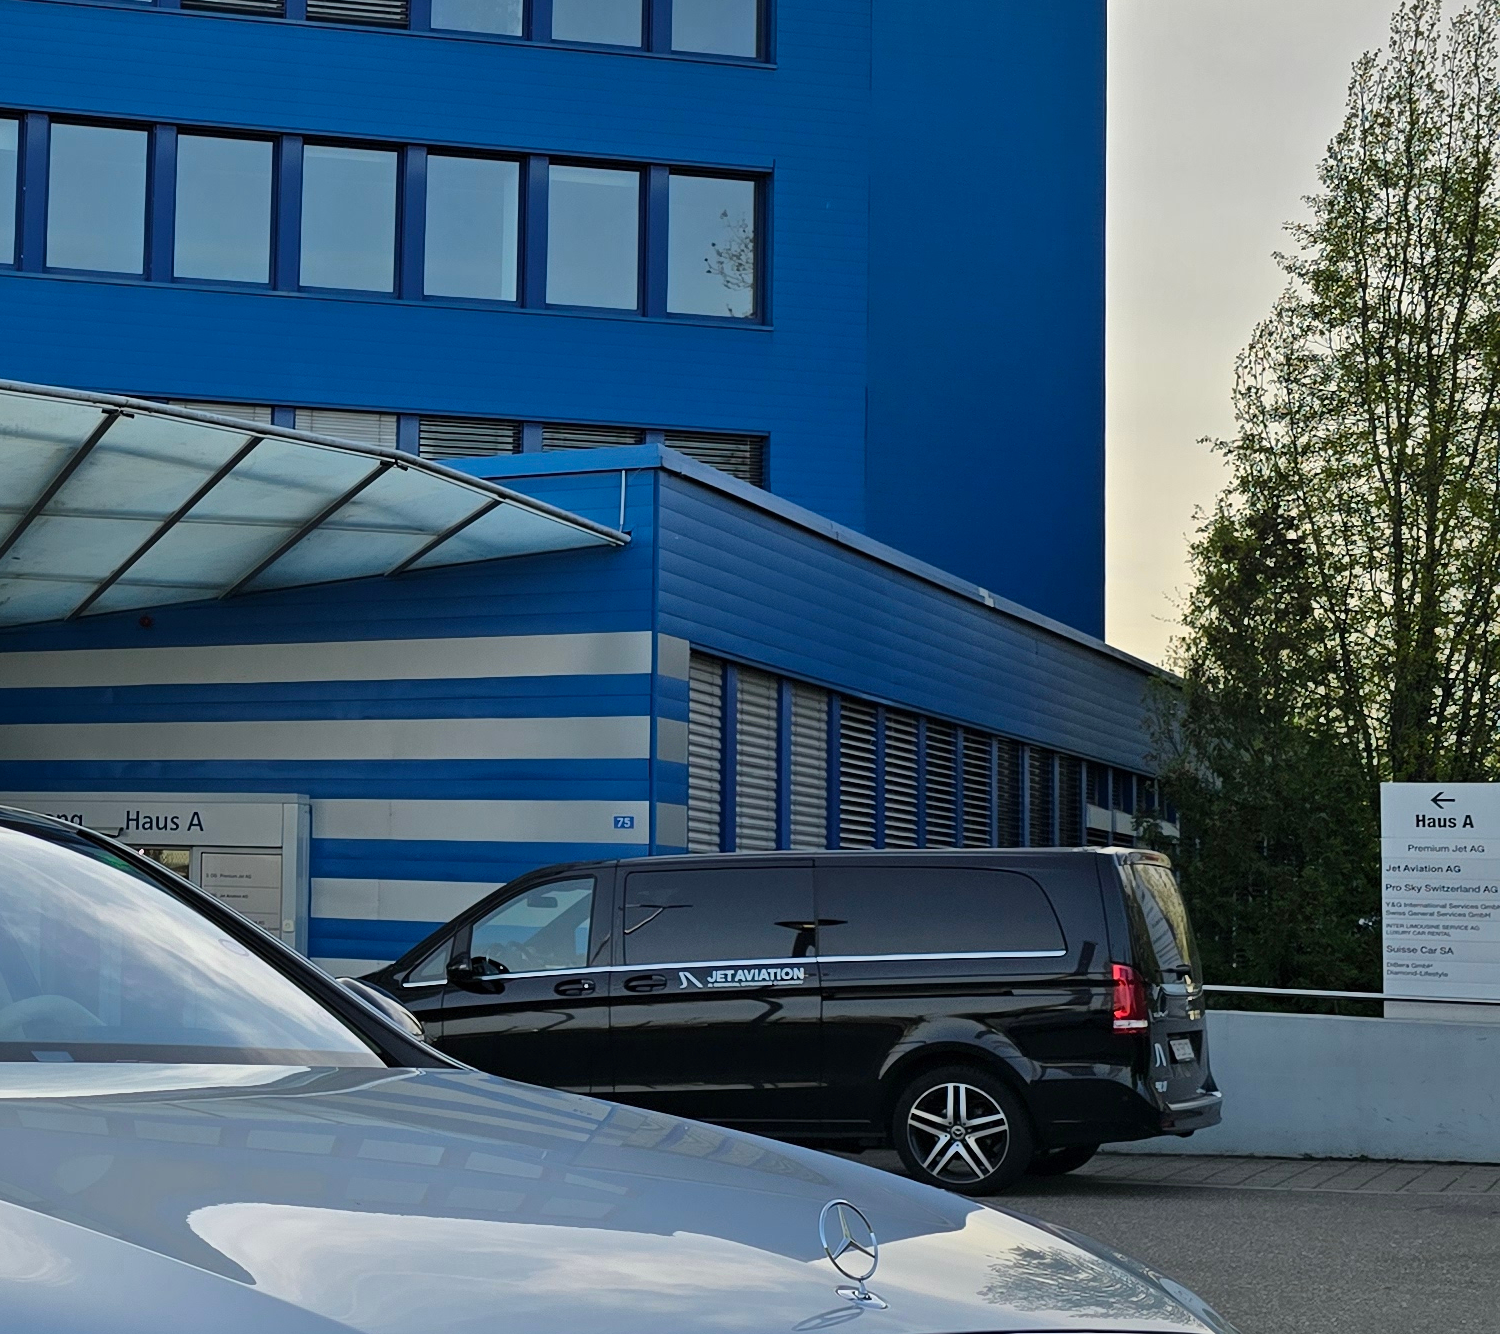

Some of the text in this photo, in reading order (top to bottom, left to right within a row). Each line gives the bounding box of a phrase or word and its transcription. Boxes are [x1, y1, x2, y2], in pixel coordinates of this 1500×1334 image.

[125, 810, 204, 832] Haus A
[616, 817, 631, 828] 75
[1415, 814, 1475, 829] Haus A
[1407, 844, 1485, 853] Premium Jet AG
[1385, 864, 1462, 873] Jet Aviation AG
[1385, 883, 1498, 893] Pro Sky Switzerland AG
[1449, 902, 1478, 910] Services
[1386, 945, 1454, 955] Suisse Car SA
